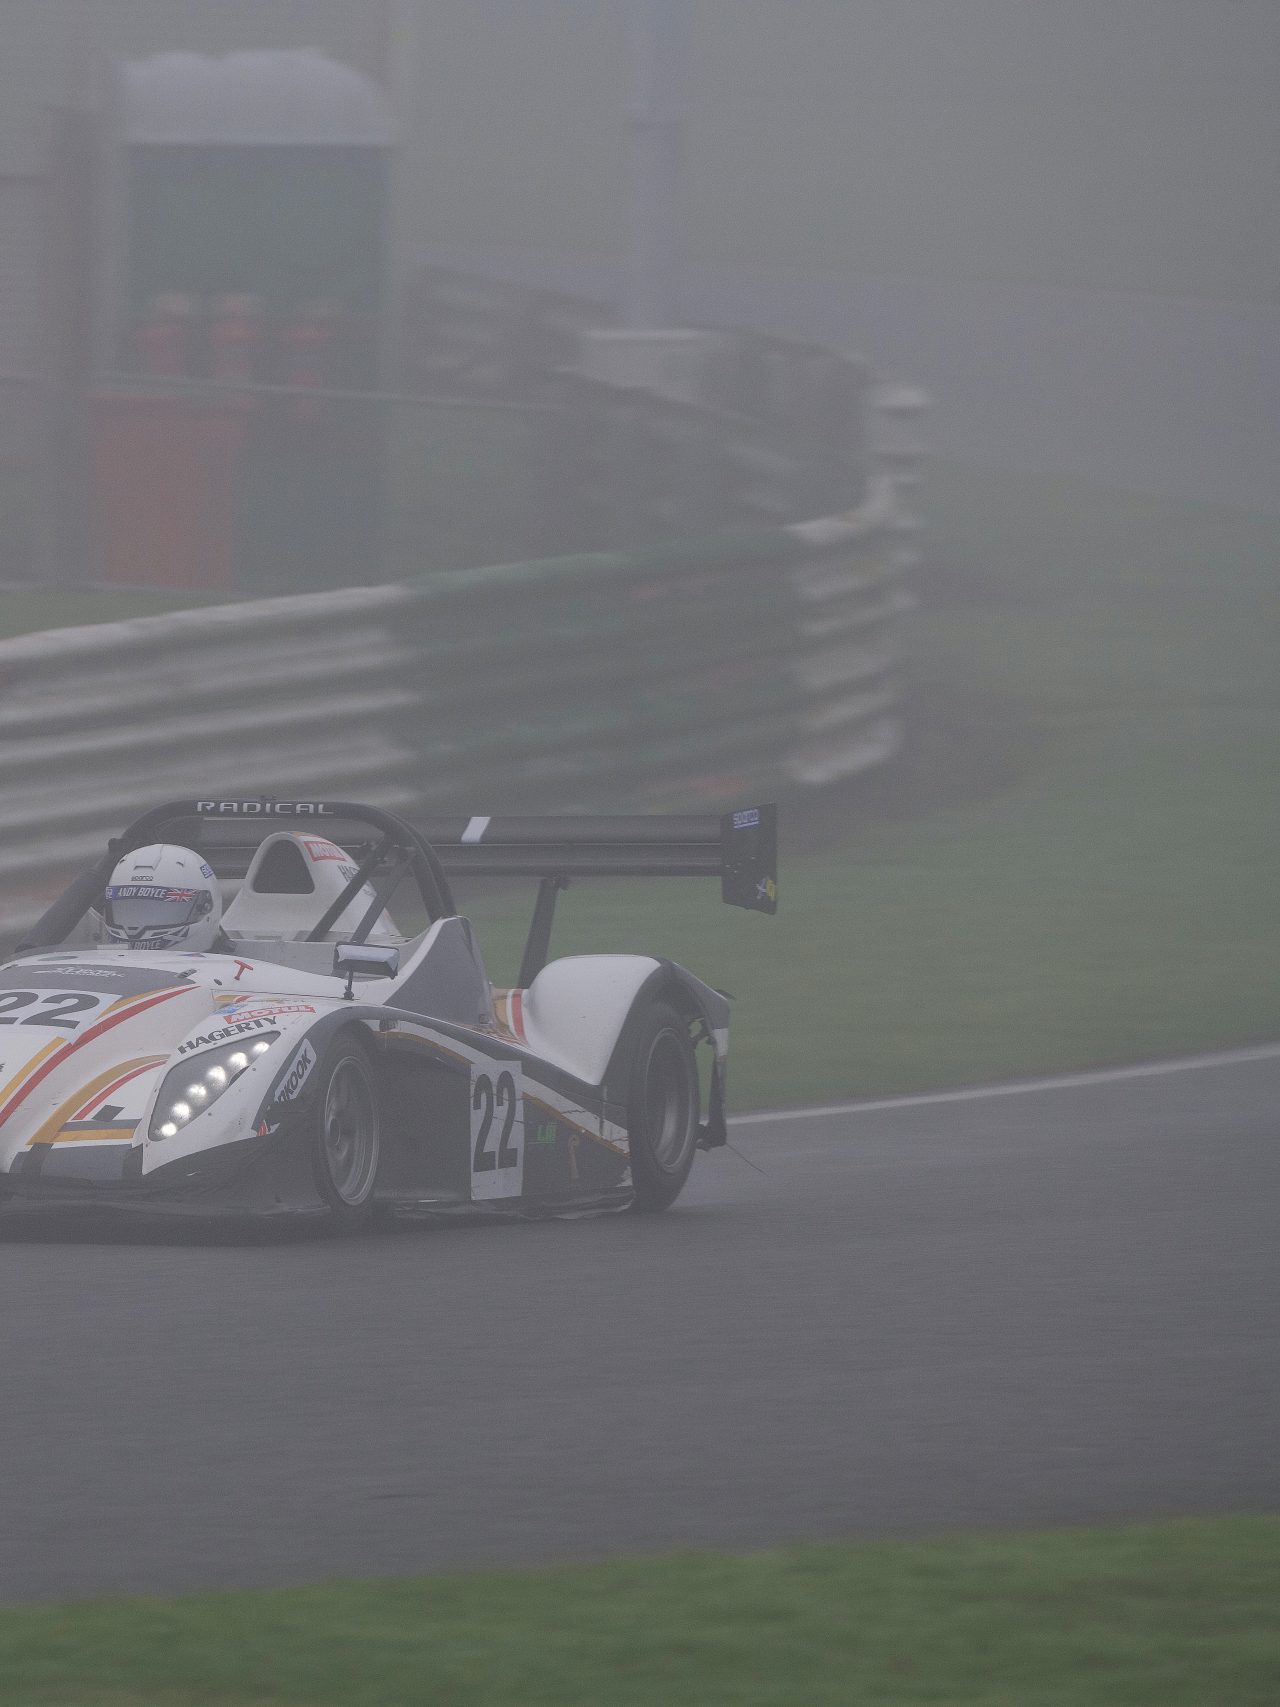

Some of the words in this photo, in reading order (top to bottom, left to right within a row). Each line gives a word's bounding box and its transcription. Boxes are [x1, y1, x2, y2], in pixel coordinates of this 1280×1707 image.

[197, 801, 334, 815] RADICAL
[117, 887, 138, 898] ANDY
[137, 887, 167, 899] BOYCE
[228, 1004, 314, 1022] MOTUL
[177, 1015, 277, 1054] HAGERTY
[472, 1070, 518, 1173] 22
